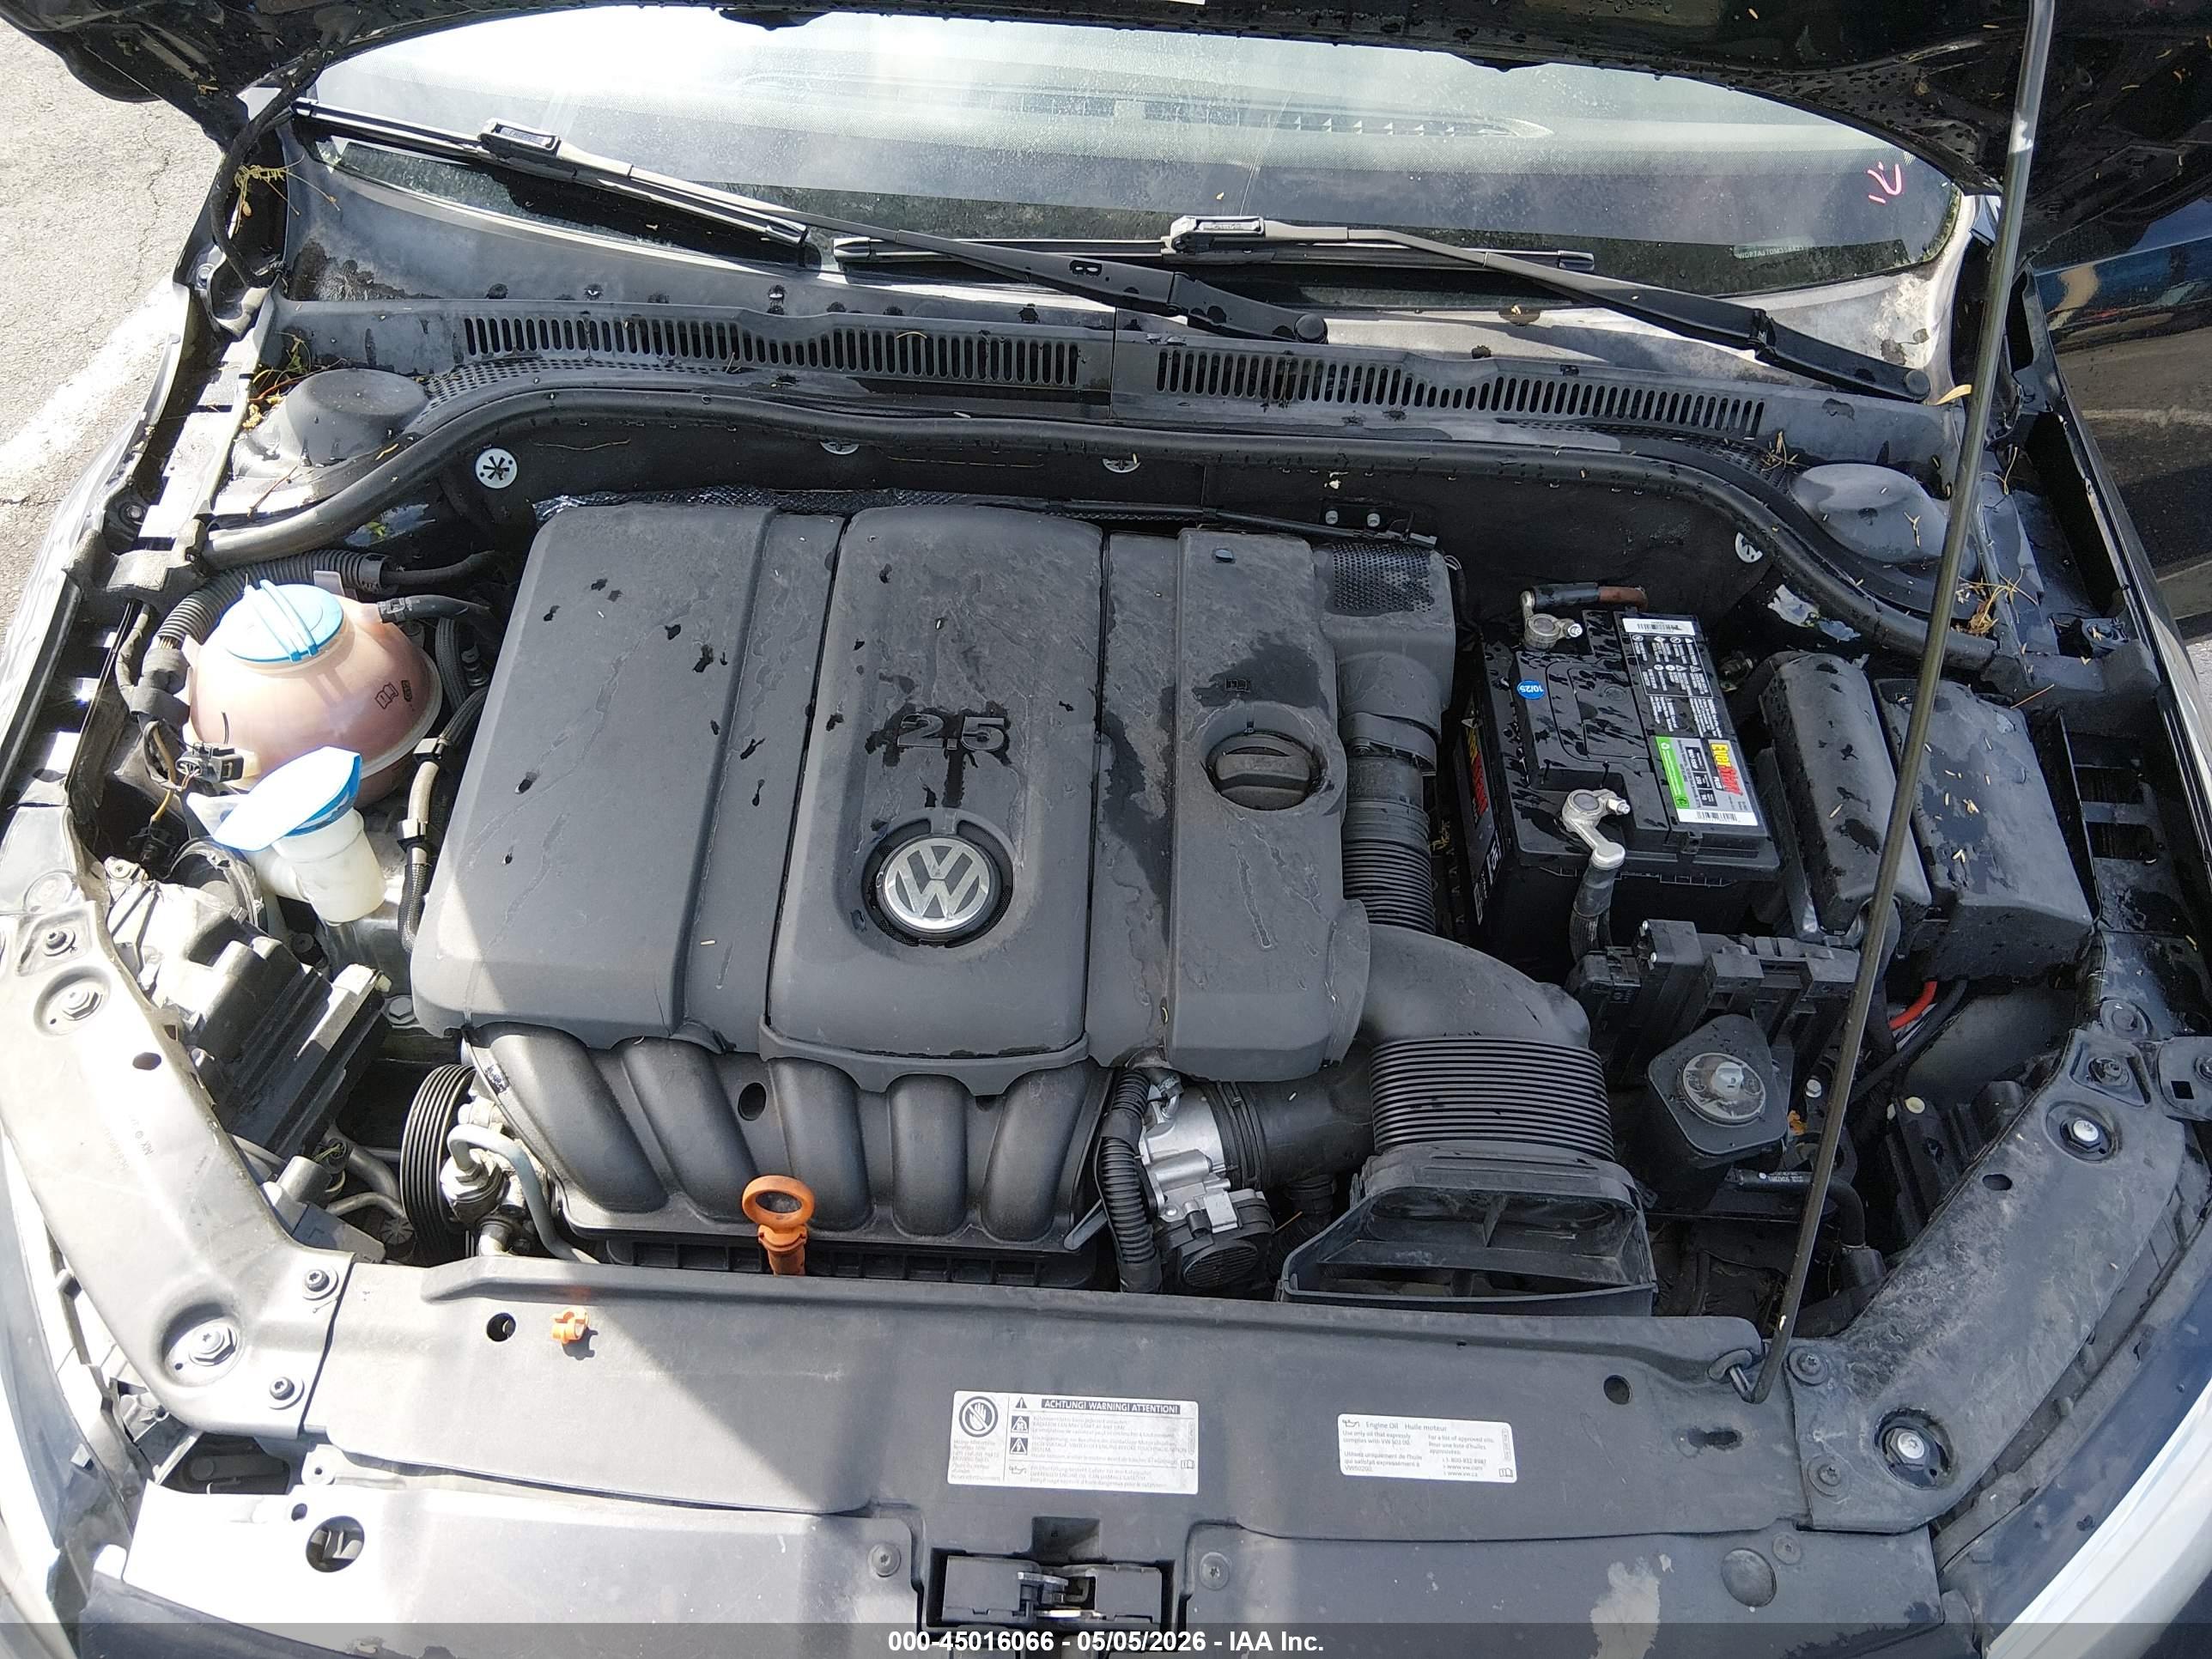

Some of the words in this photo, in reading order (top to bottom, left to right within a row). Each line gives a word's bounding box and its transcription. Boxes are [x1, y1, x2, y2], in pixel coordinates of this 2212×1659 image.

[897, 713, 1004, 750] 2.5
[1711, 744, 1743, 795] EverStart
[889, 840, 987, 923] VW
[1044, 1400, 1086, 1409] ACHTUNG!
[1088, 1401, 1130, 1411] WARNING!
[1131, 1404, 1178, 1413] ATTENTION!
[1366, 1421, 1388, 1430] Engine
